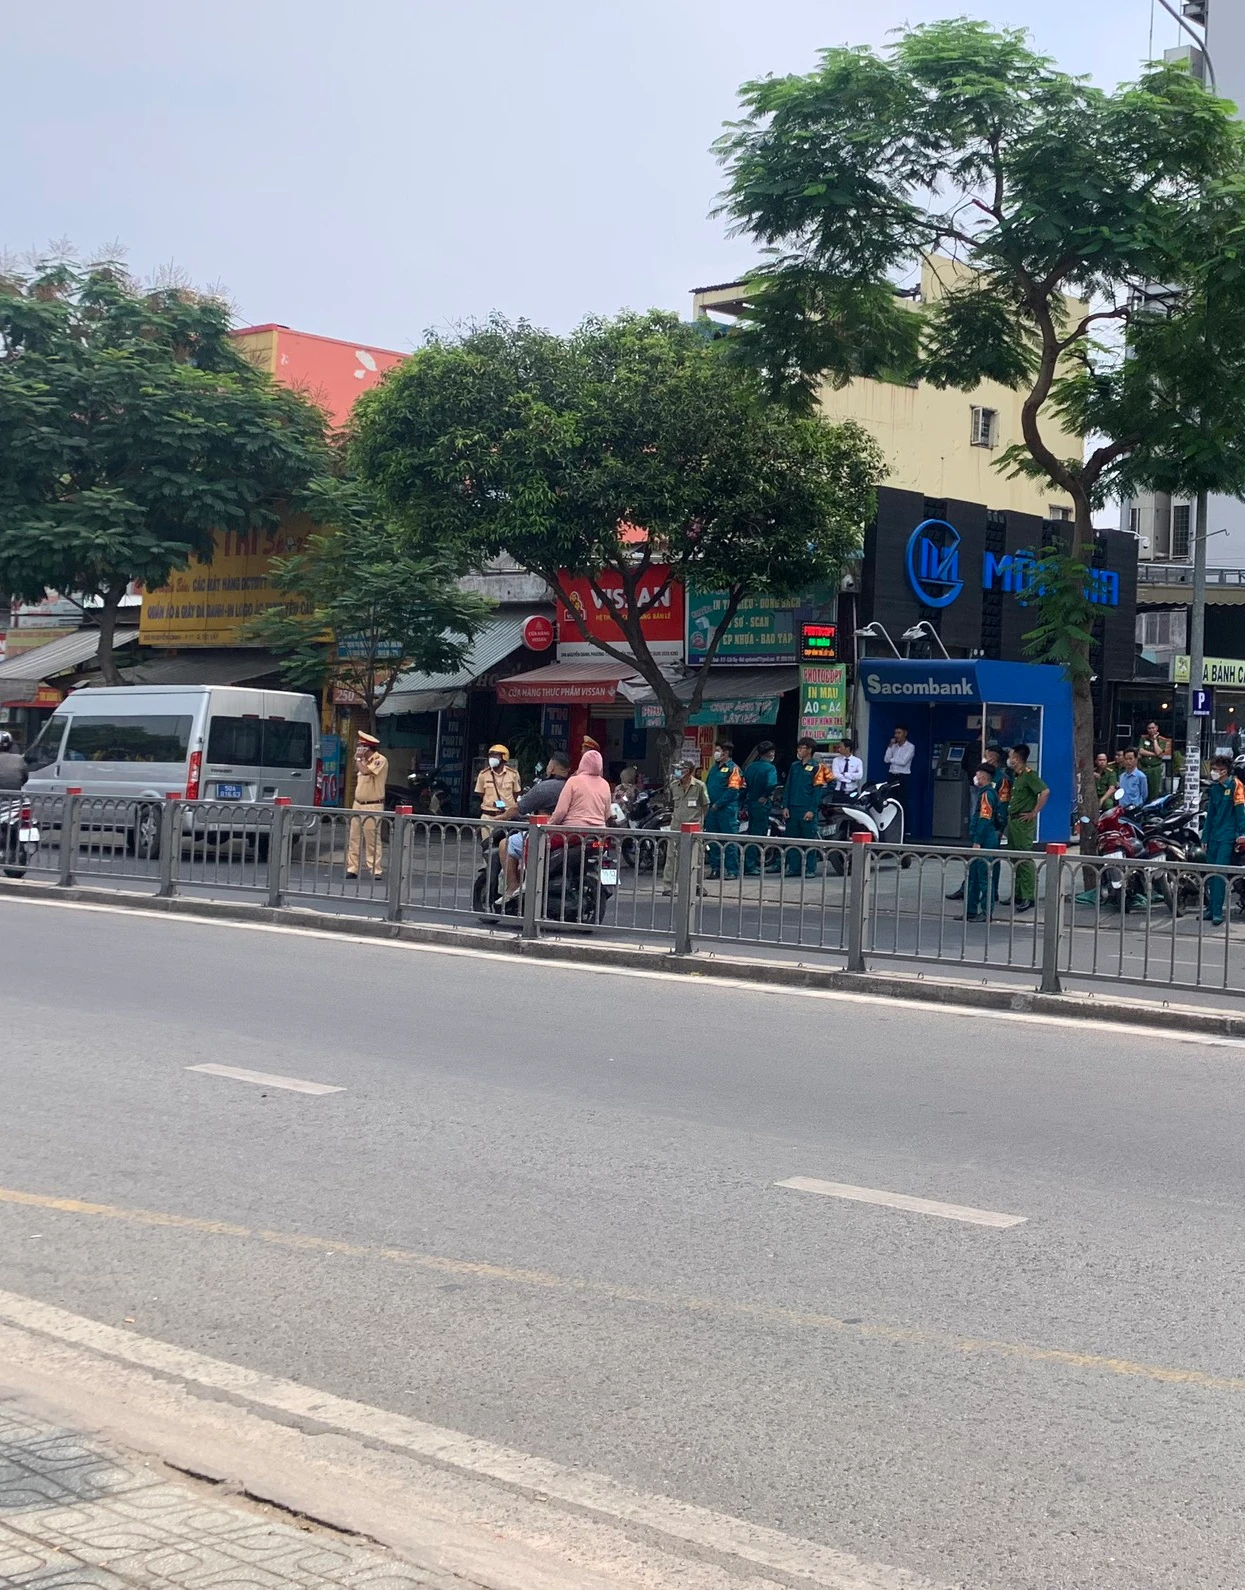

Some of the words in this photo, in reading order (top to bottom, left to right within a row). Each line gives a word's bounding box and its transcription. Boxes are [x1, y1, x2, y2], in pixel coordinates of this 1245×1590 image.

[803, 669, 843, 684] PHOTOCOPY
[1211, 661, 1236, 683] BÁNH
[867, 673, 974, 695] Sacombank
[337, 690, 355, 701] 250
[522, 687, 541, 697] HÀNG
[581, 687, 606, 696] VISSAN
[808, 686, 817, 698] IN
[804, 701, 819, 714] A0
[1198, 692, 1206, 709] P
